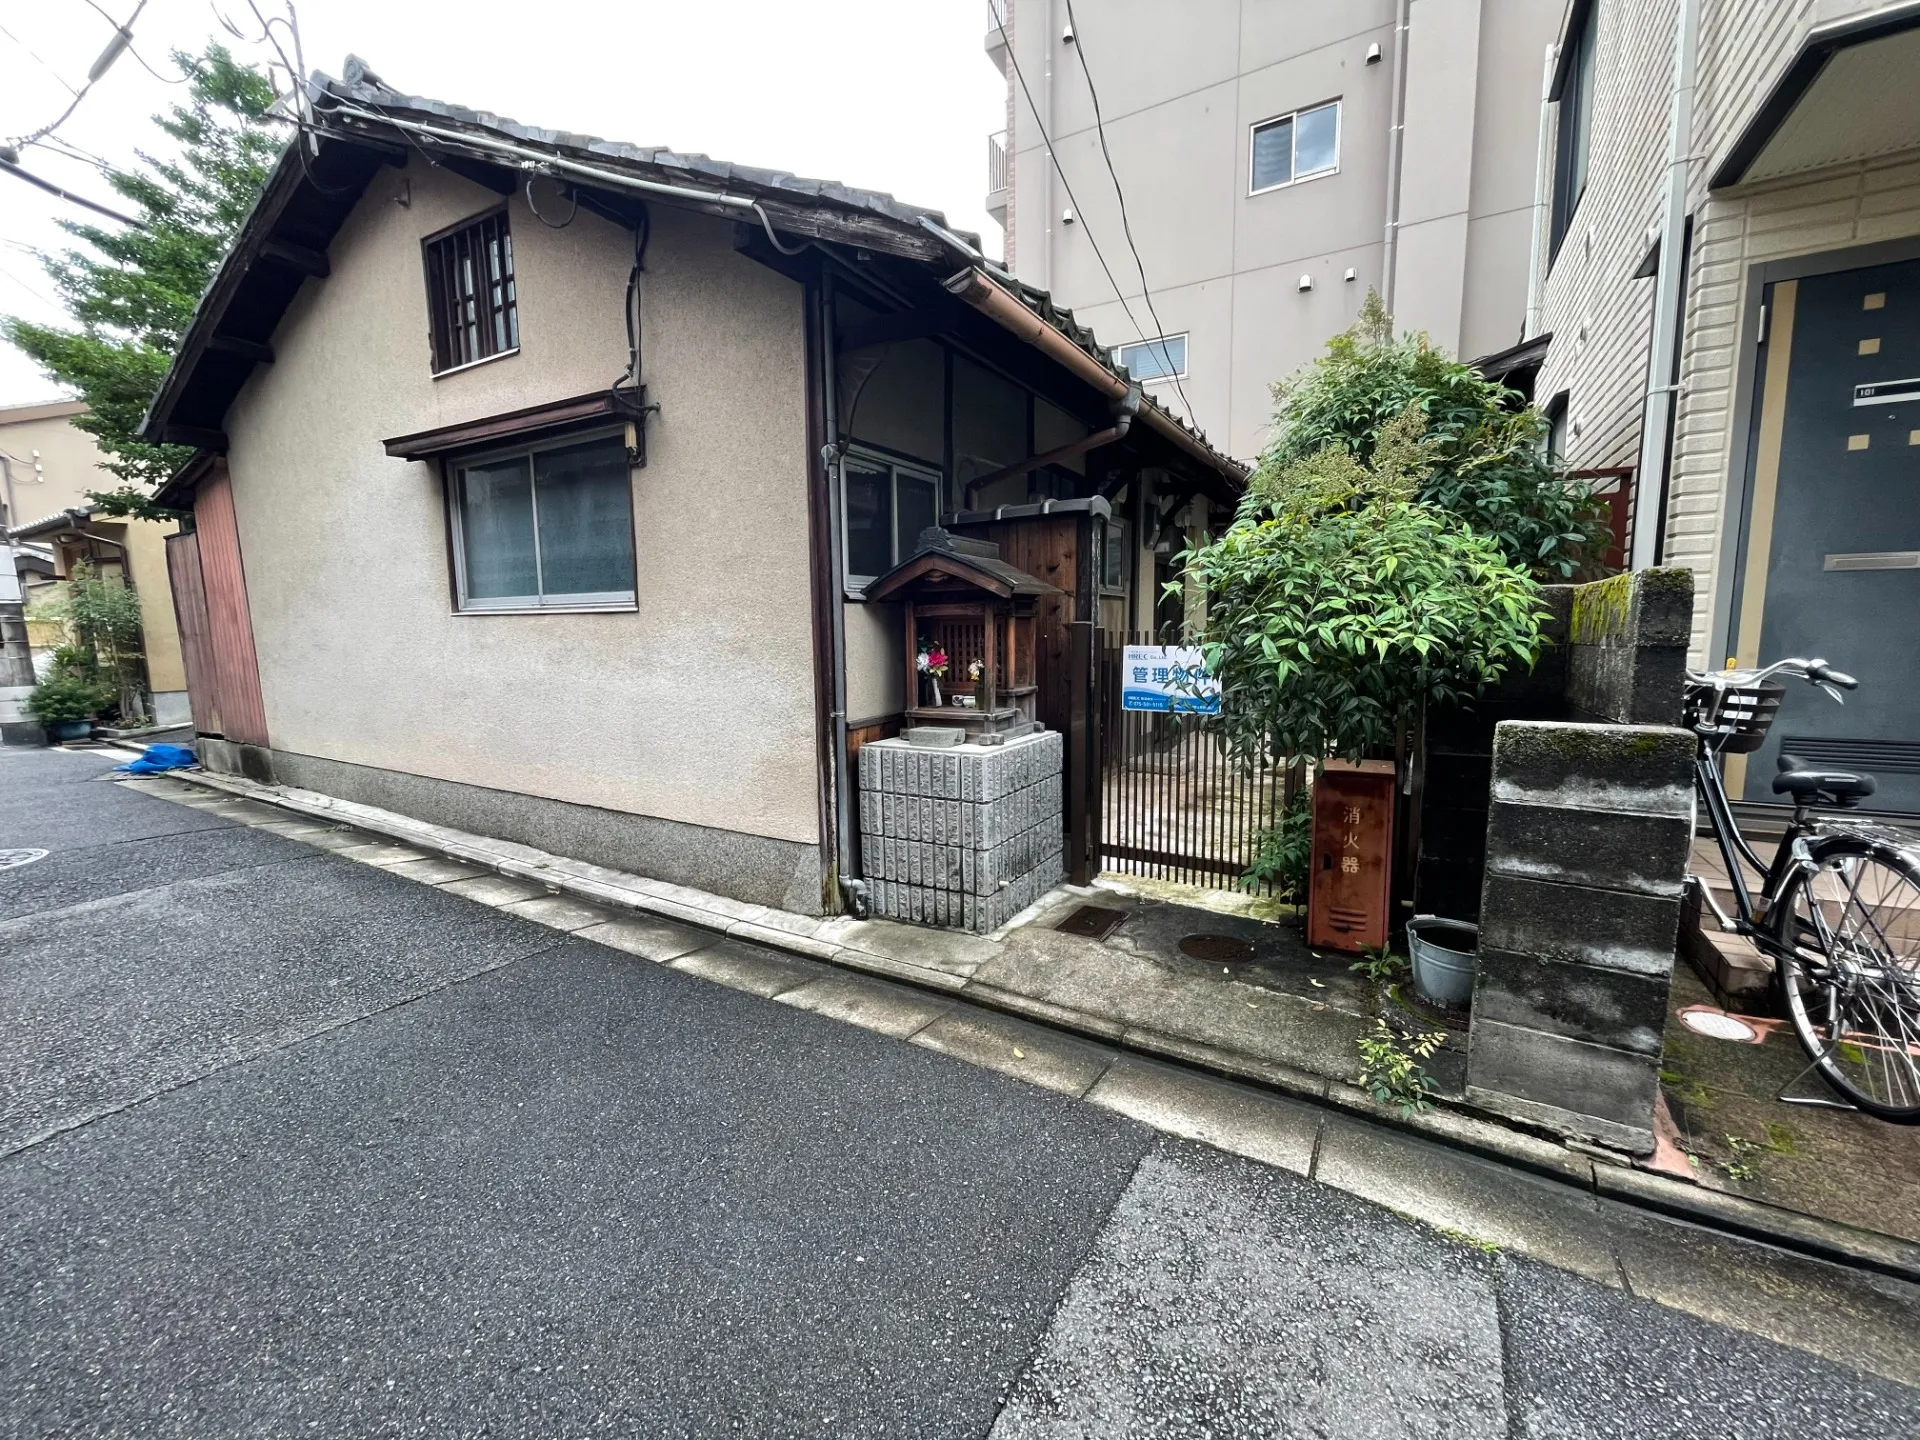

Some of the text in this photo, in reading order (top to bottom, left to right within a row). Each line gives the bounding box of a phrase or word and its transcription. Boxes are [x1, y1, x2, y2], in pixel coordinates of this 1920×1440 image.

[1860, 388, 1875, 397] 101
[1341, 806, 1361, 874] 消火器
